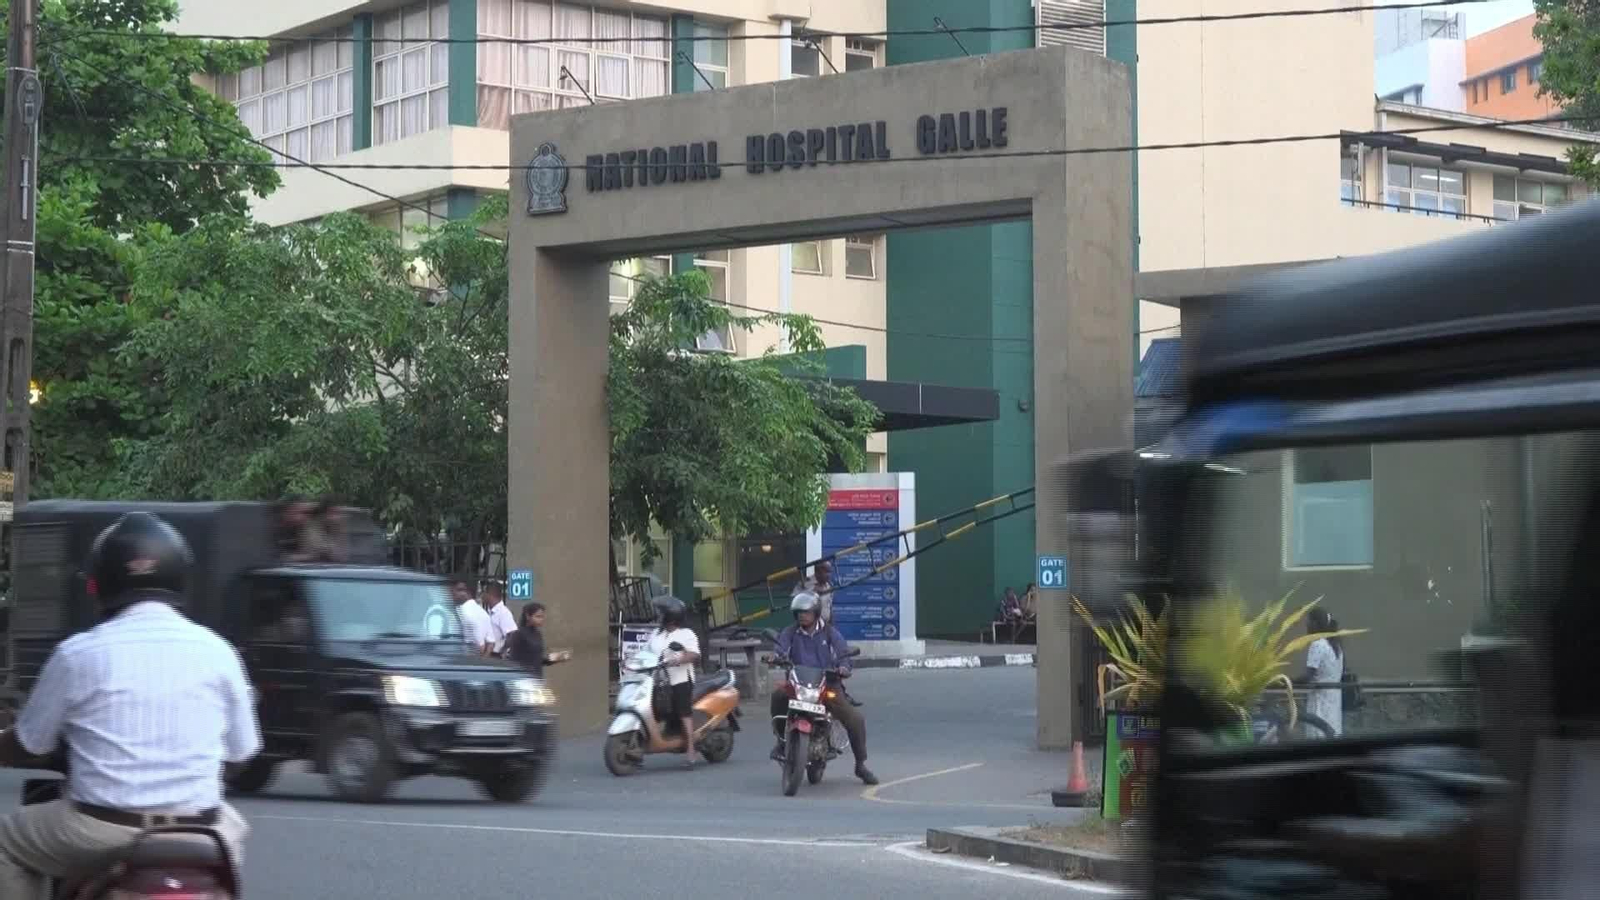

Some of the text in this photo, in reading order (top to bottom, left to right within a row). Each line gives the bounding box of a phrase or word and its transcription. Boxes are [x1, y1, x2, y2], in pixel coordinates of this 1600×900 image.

[586, 107, 1008, 192] NATIONAL HOSPITAL GALLE
[1041, 559, 1064, 567] GATE
[511, 572, 530, 580] GATE
[1042, 569, 1062, 585] 01
[512, 582, 529, 597] 01
